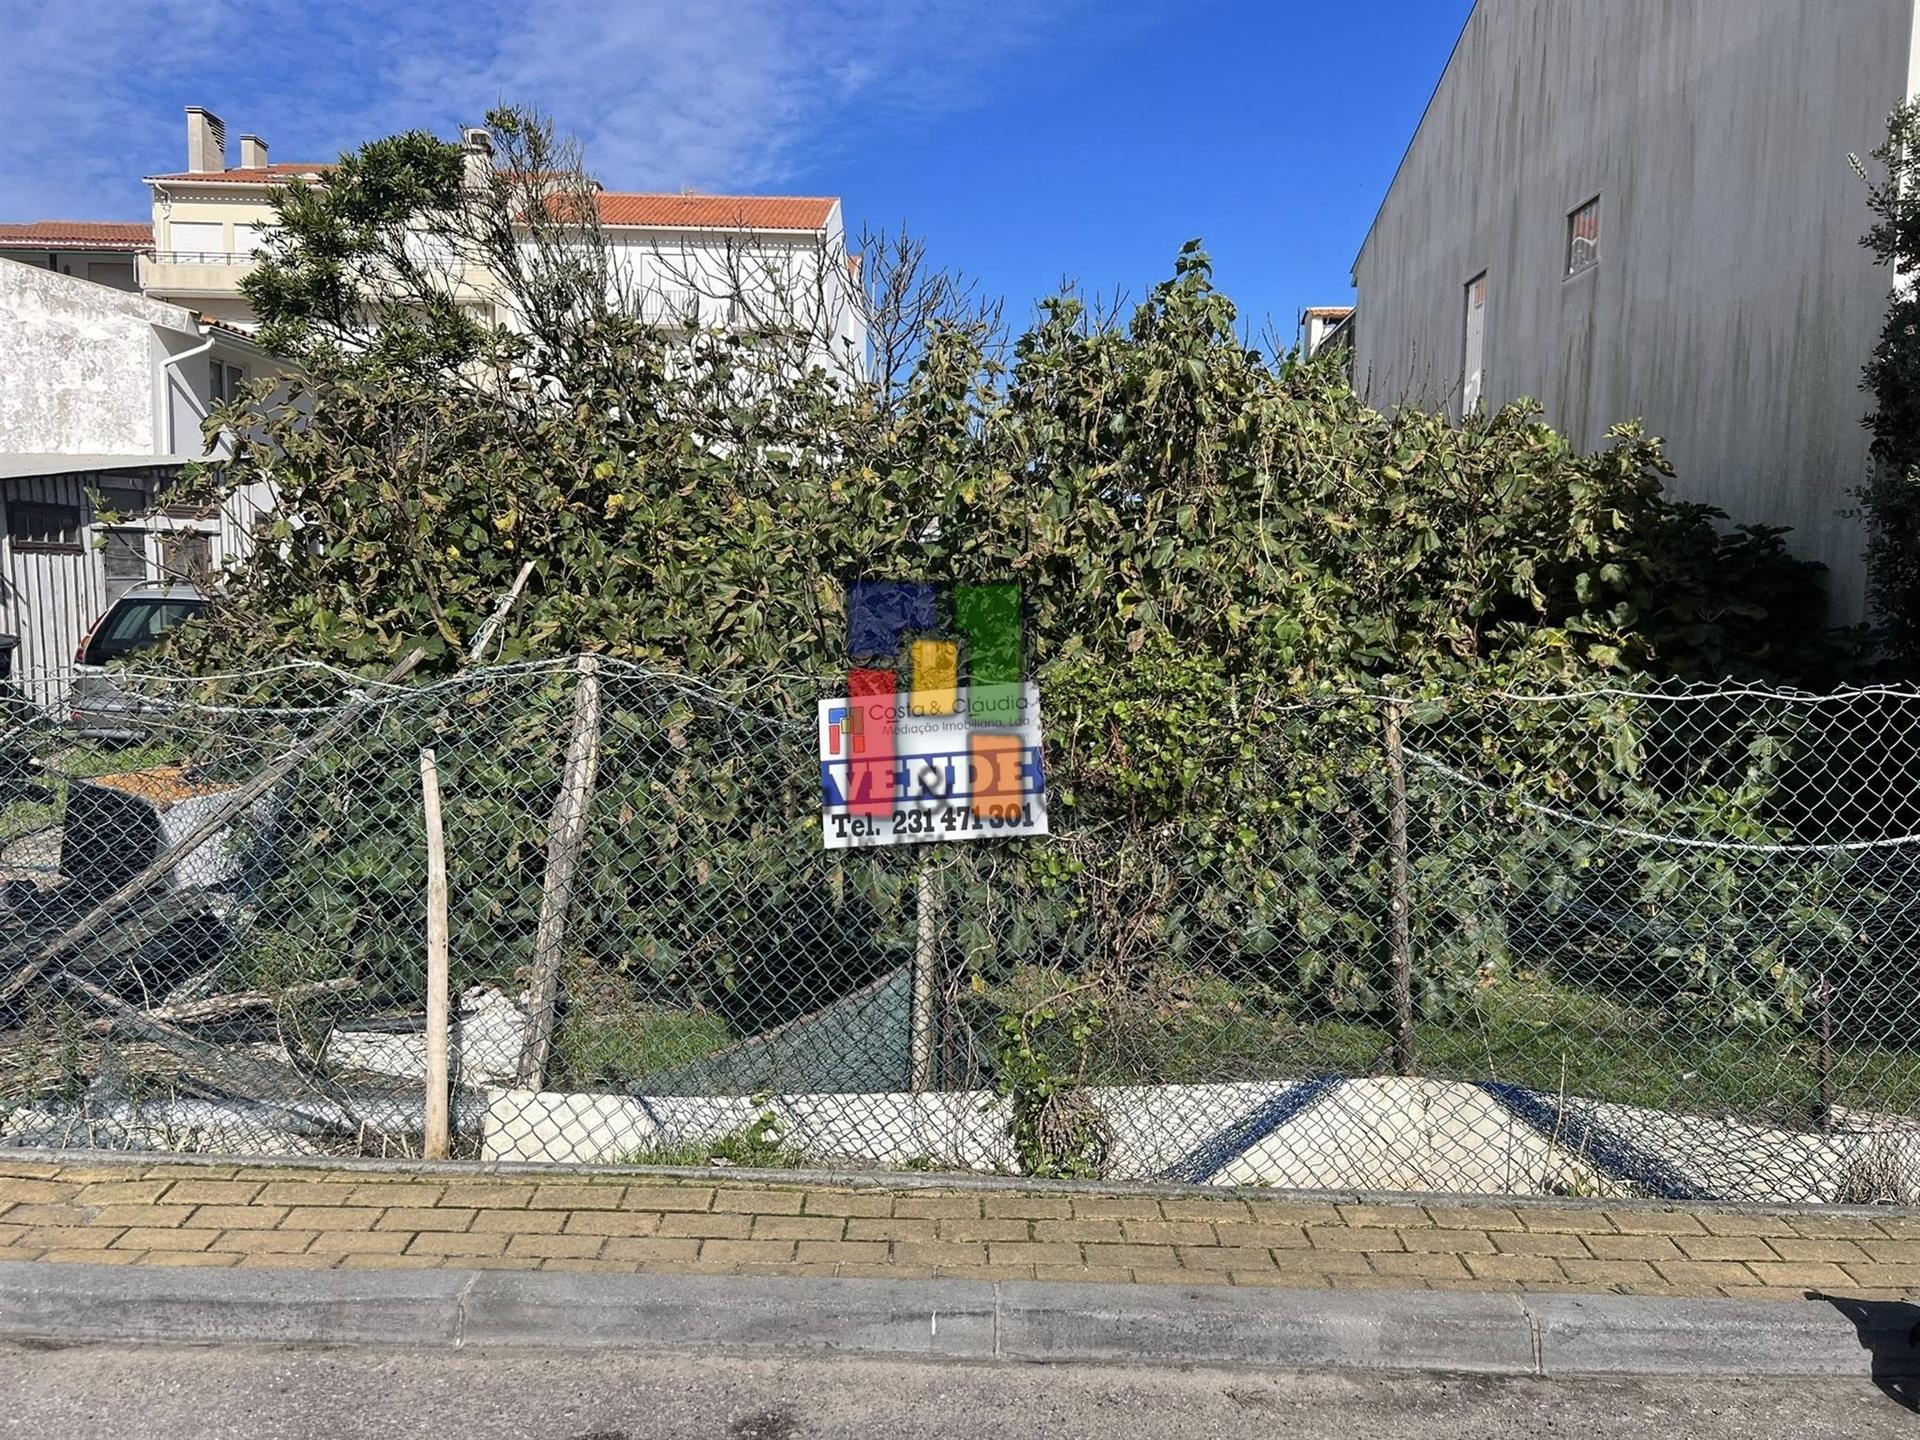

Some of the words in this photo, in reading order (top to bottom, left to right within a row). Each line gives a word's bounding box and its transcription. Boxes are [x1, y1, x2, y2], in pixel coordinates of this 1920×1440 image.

[869, 704, 925, 721] Costa
[929, 701, 943, 715] &
[952, 695, 1028, 714] Cláudia
[882, 721, 939, 736] Mediação
[829, 750, 1034, 801] VENDE
[831, 812, 880, 838] Tel.
[892, 808, 935, 834] 231
[940, 805, 983, 831] 471
[989, 802, 1034, 828] 301
